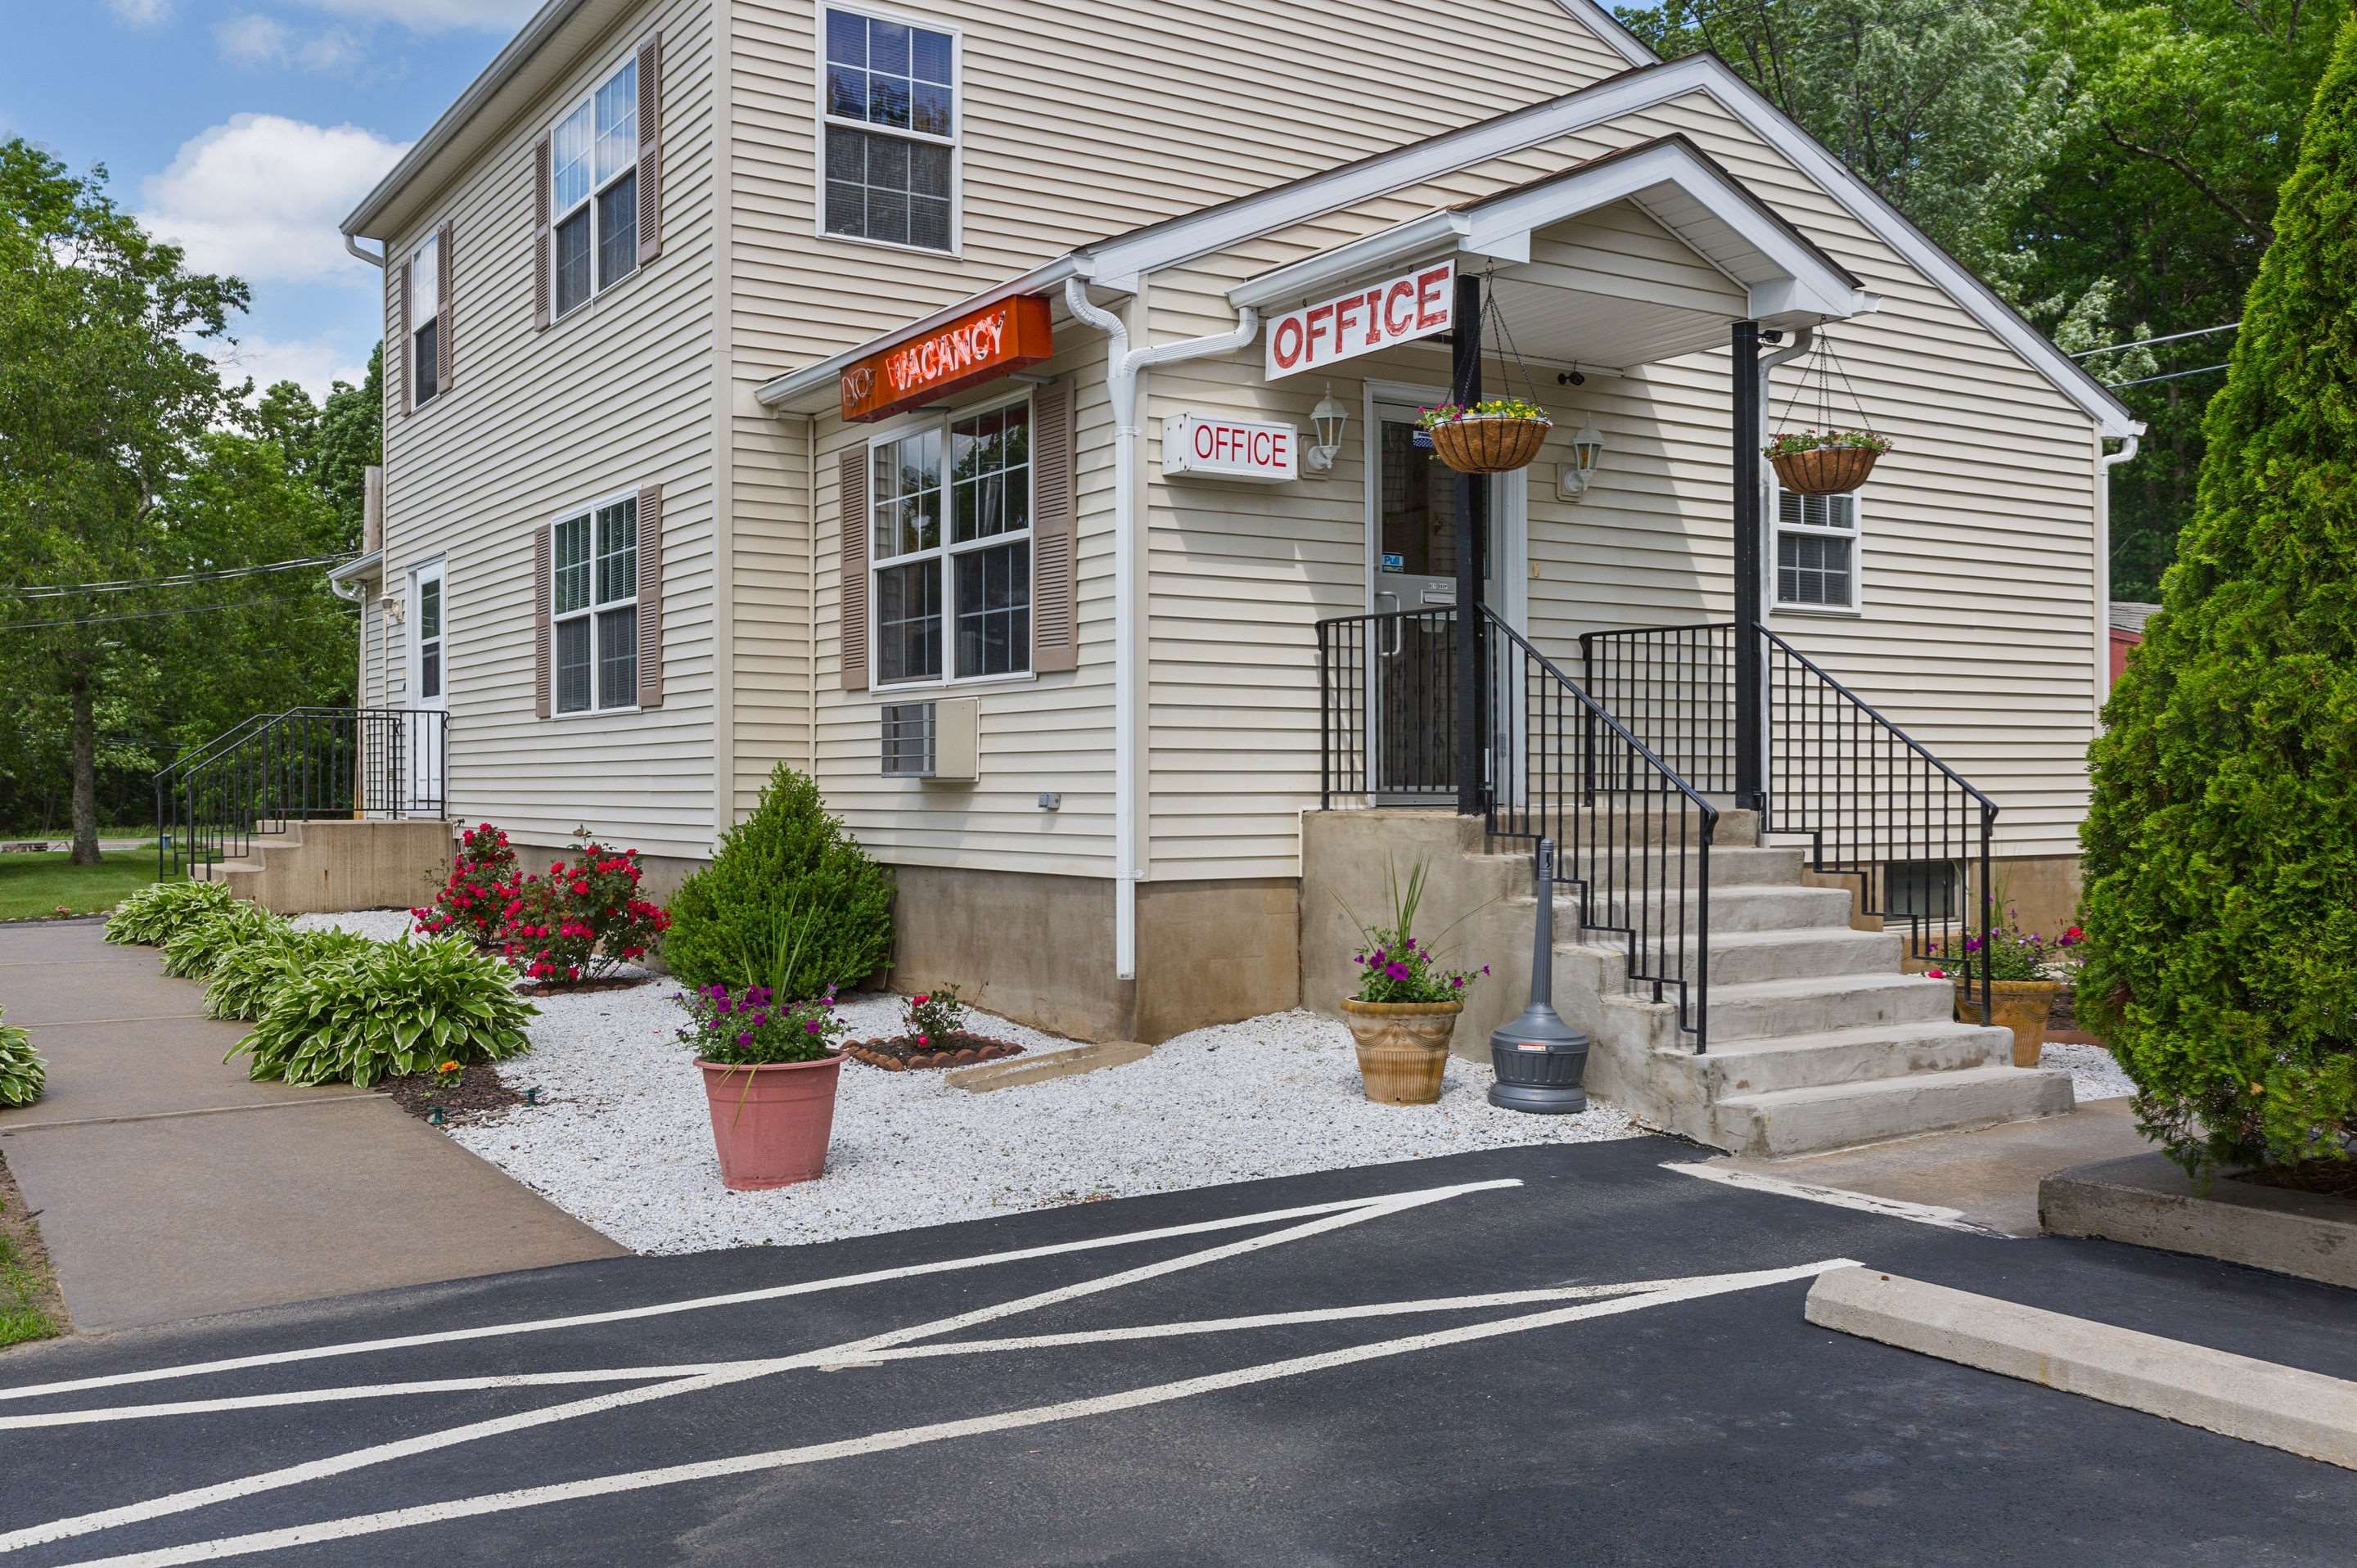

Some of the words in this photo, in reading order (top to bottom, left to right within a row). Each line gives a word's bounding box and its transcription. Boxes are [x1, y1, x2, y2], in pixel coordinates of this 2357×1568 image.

[1273, 266, 1449, 369] OFFICE
[841, 367, 872, 404] NO
[886, 310, 1006, 391] VACANCY
[1195, 424, 1287, 467] OFFICE
[1384, 555, 1400, 565] Pull
